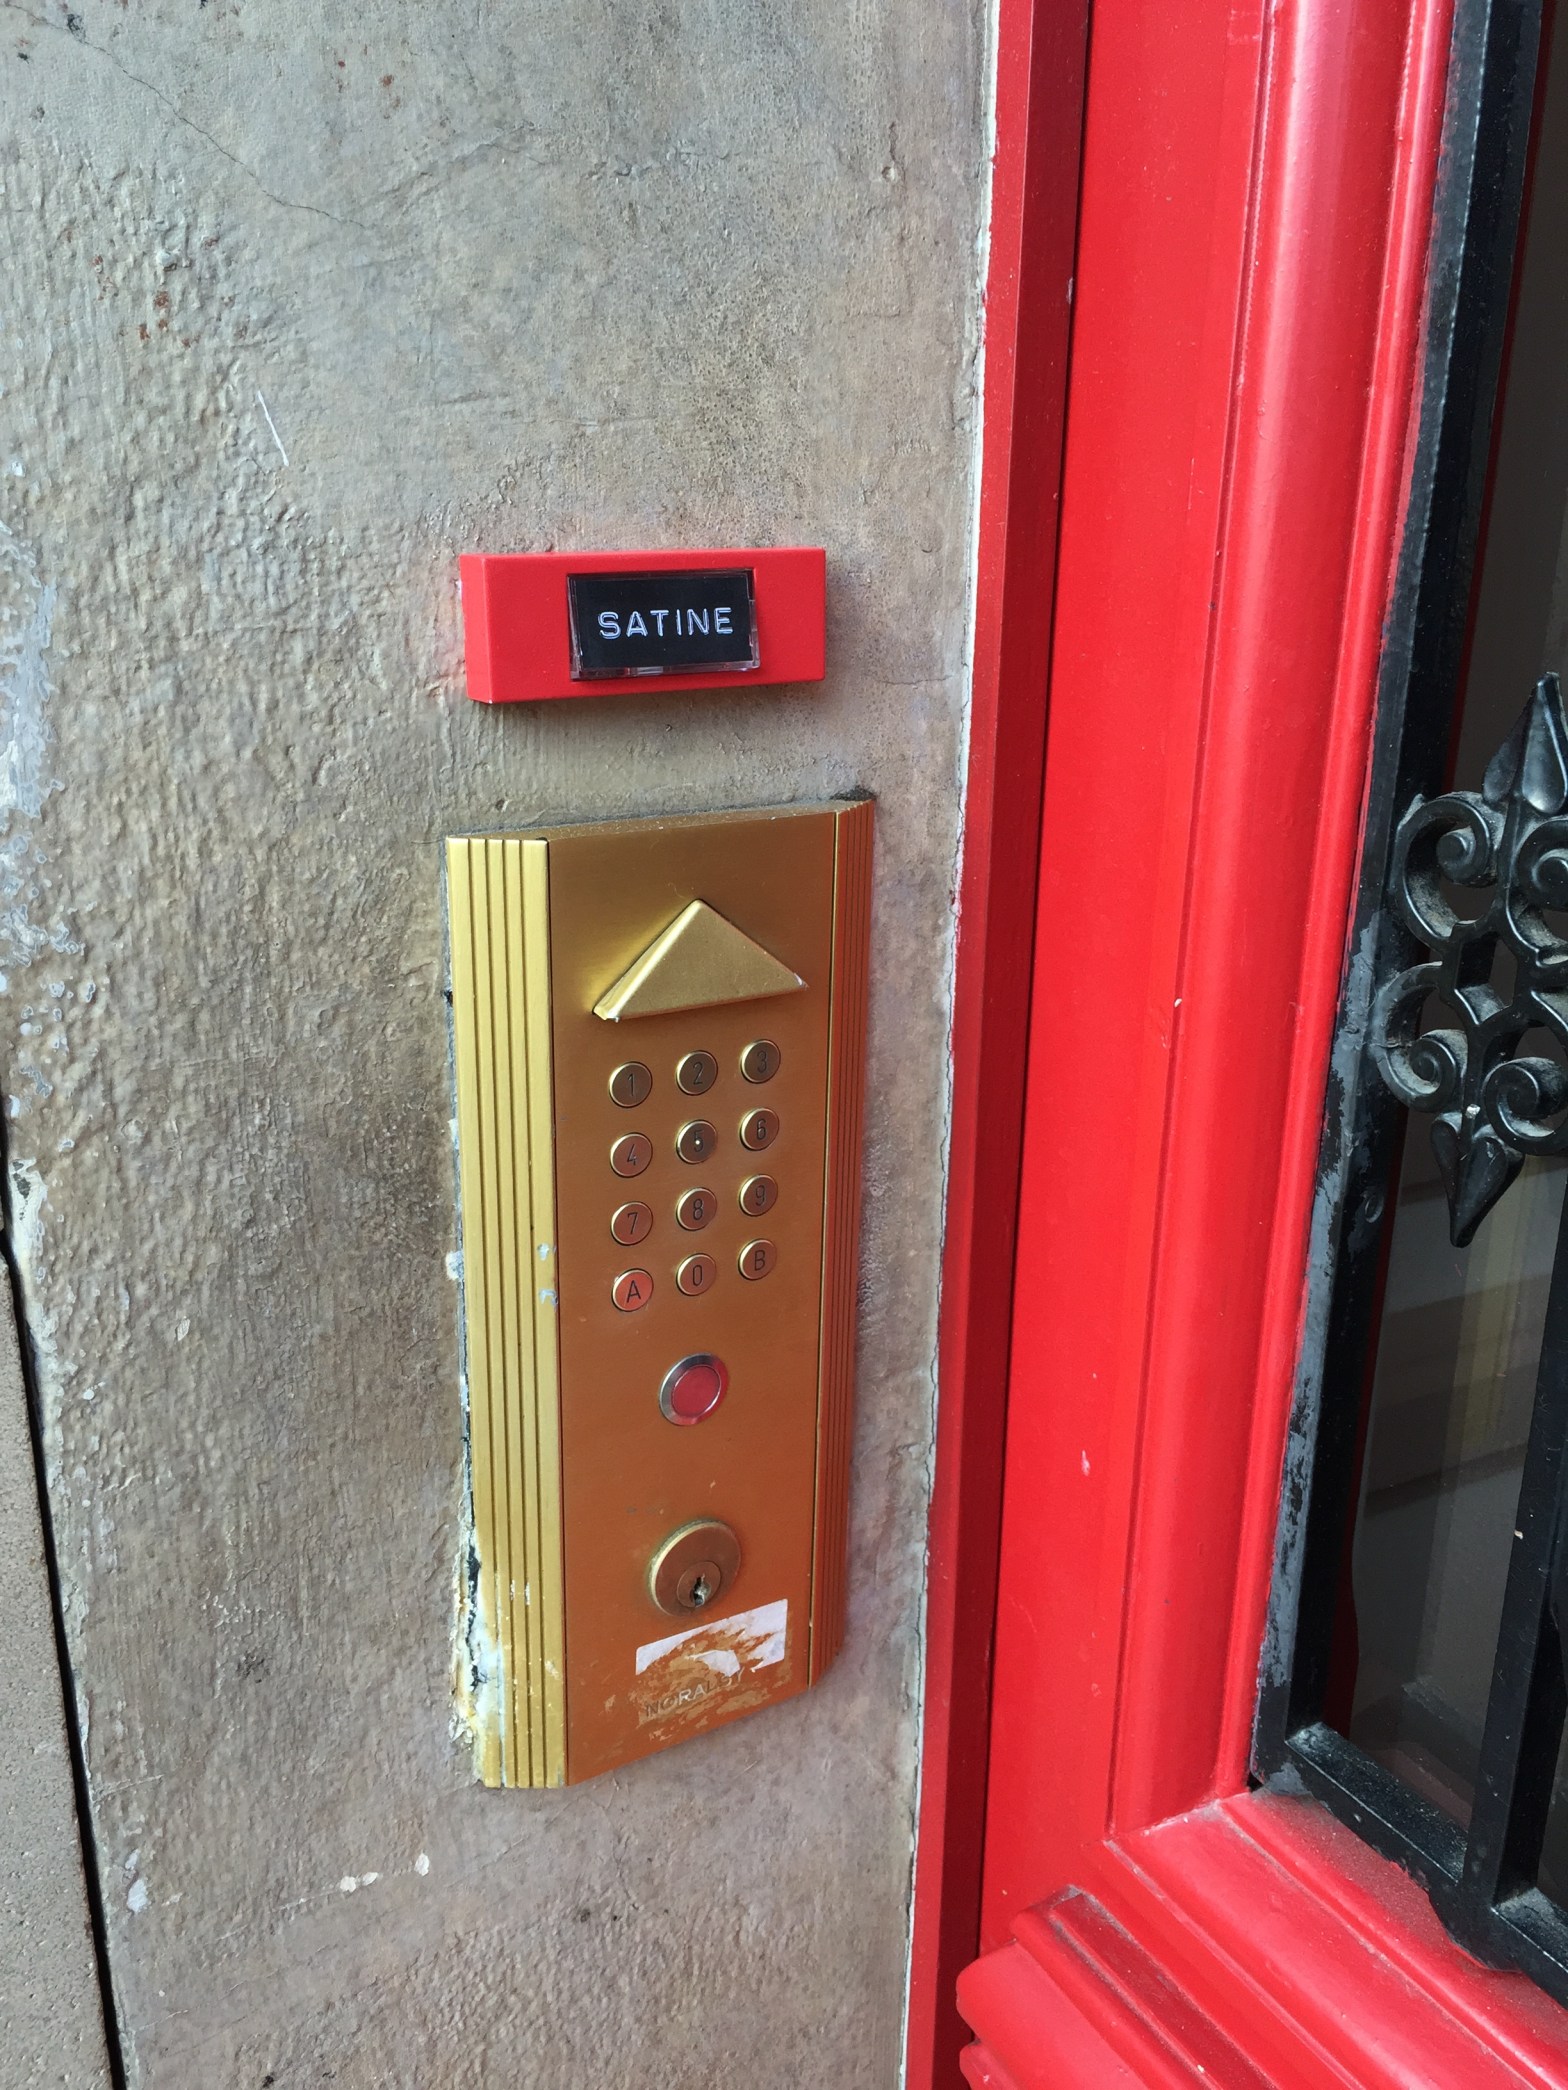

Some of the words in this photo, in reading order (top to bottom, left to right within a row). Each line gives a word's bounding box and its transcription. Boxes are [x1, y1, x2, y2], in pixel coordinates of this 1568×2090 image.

[597, 606, 734, 640] SATINE
[627, 1072, 637, 1098] 1
[692, 1060, 704, 1086] 2
[756, 1049, 768, 1074] 3
[626, 1143, 638, 1166] 4
[692, 1129, 705, 1153] 5
[755, 1117, 767, 1142] 6
[626, 1211, 639, 1235] 7
[692, 1198, 705, 1221] 8
[755, 1184, 767, 1207] 9
[625, 1279, 642, 1304] A
[692, 1264, 703, 1287] 0
[753, 1249, 766, 1271] B
